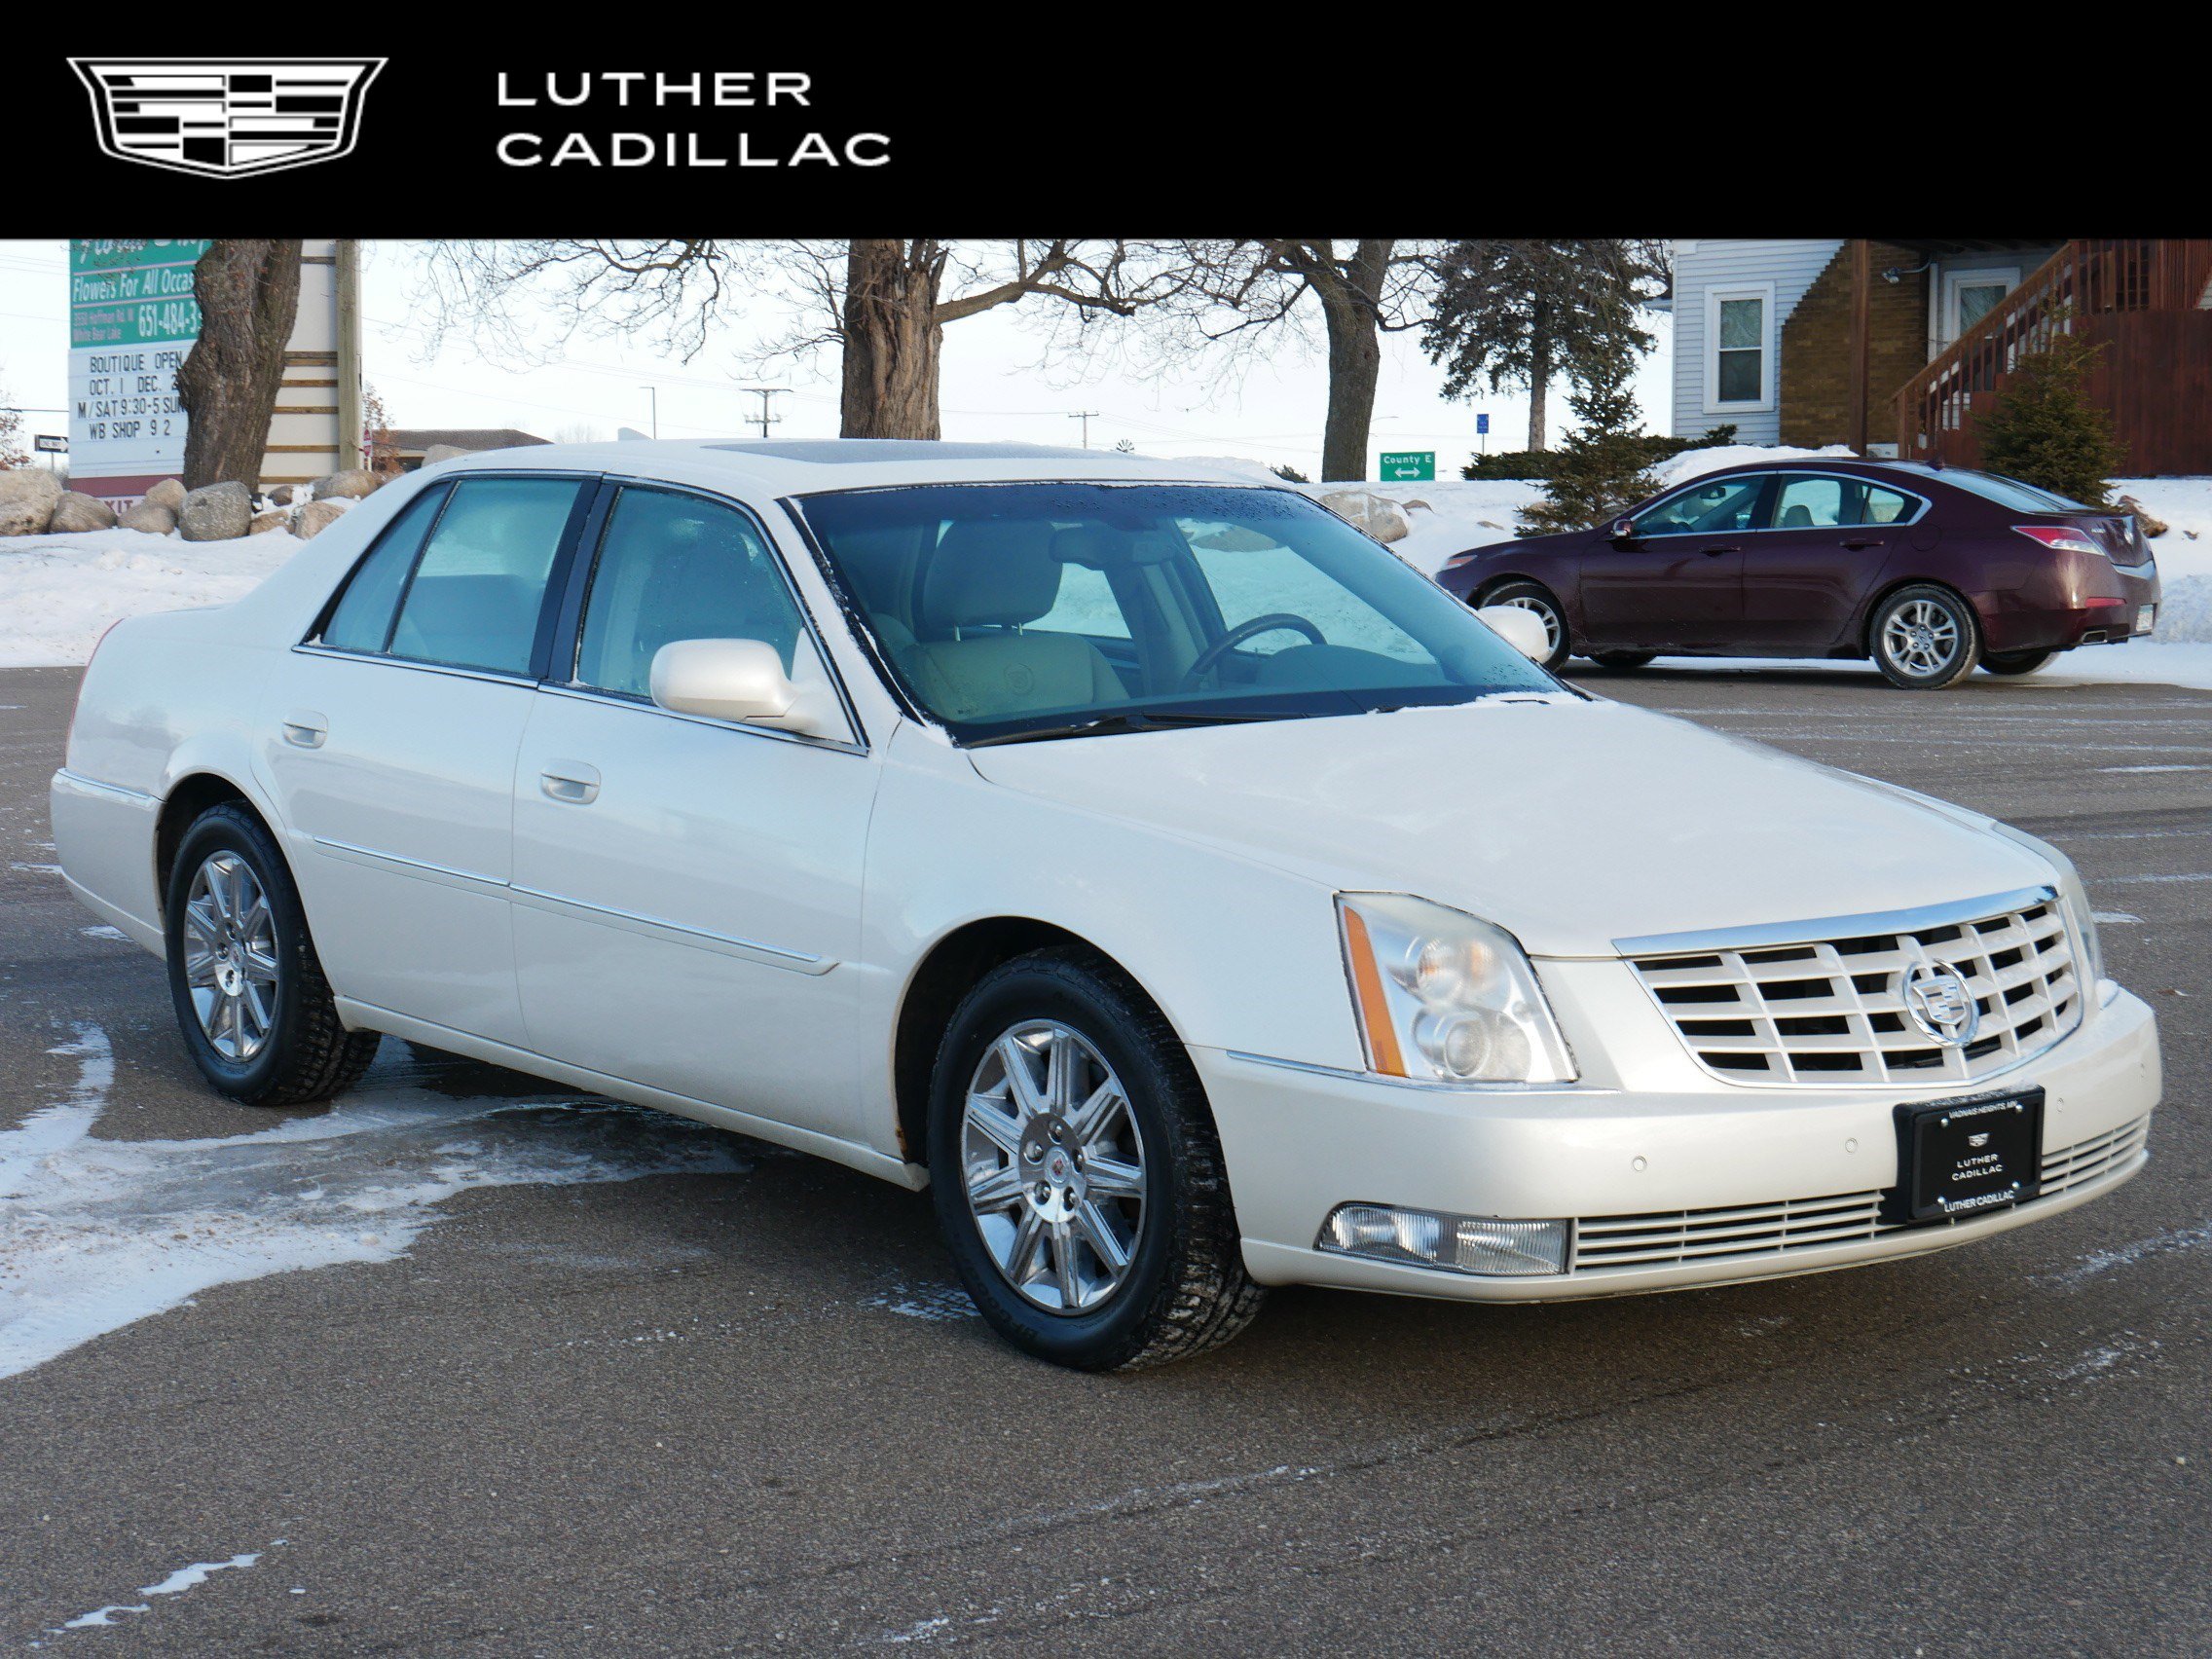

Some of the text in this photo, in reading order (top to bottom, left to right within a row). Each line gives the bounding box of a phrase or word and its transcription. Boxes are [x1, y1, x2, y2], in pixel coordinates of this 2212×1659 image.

[73, 276, 117, 302] Flowers
[120, 273, 138, 297] For
[142, 268, 159, 295] All
[90, 350, 182, 373] BOUTIQUE OPEN
[90, 378, 114, 395] OCT.
[137, 375, 162, 392] DEC.
[90, 419, 170, 440] WB SHOP 9 2
[1383, 454, 1432, 465] County E
[104, 499, 133, 514] XIT
[1957, 1154, 1998, 1167] LUTHER
[1952, 1164, 2002, 1180] CADILLAC
[1944, 1190, 2013, 1212] LUTHER CADILLAC
